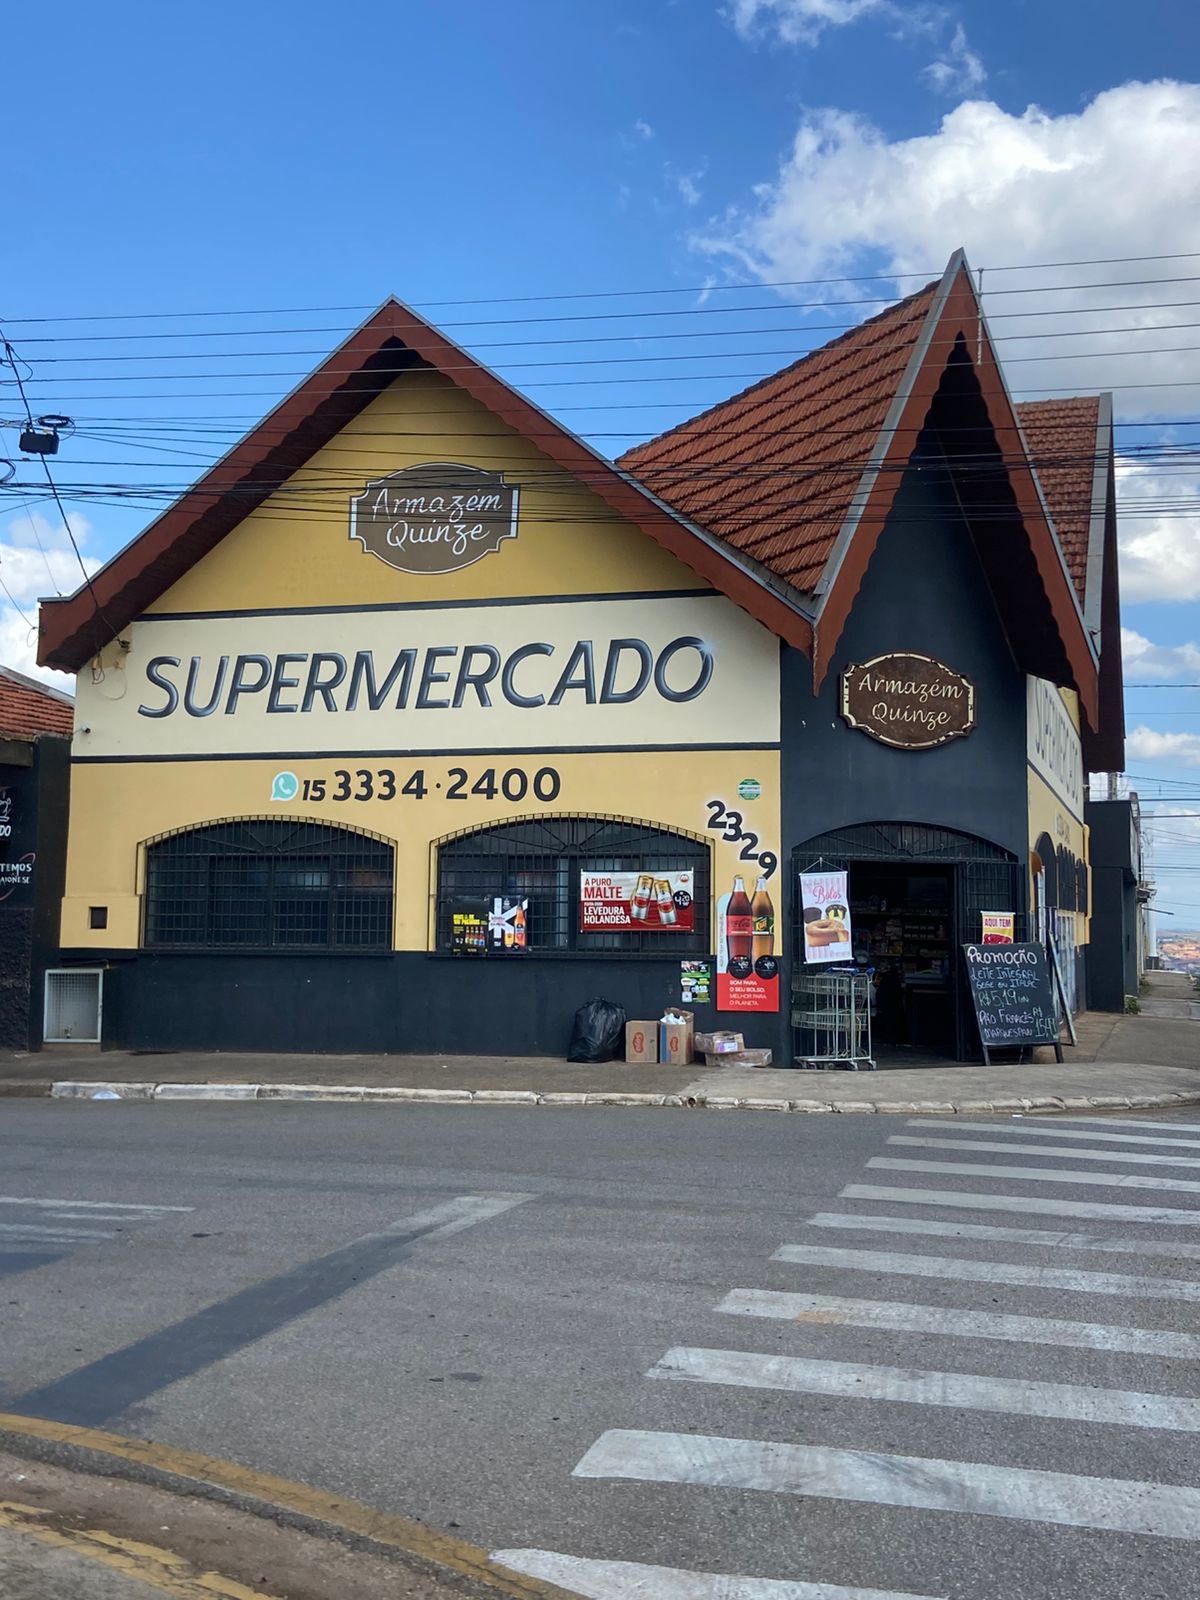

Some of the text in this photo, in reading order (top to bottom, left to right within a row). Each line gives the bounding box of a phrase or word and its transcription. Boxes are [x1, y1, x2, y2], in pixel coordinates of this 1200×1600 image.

[386, 520, 490, 555] Quinze
[137, 636, 714, 718] SUPERMERCADO
[858, 673, 963, 703] Armazém
[872, 702, 951, 730] Quinze
[303, 780, 327, 801] 15
[592, 878, 612, 886] PURO
[584, 886, 623, 899] MALTE
[584, 906, 625, 915] LEVEDURA
[584, 915, 631, 924] HOLANDESA
[984, 918, 1011, 928] AQUI TEM
